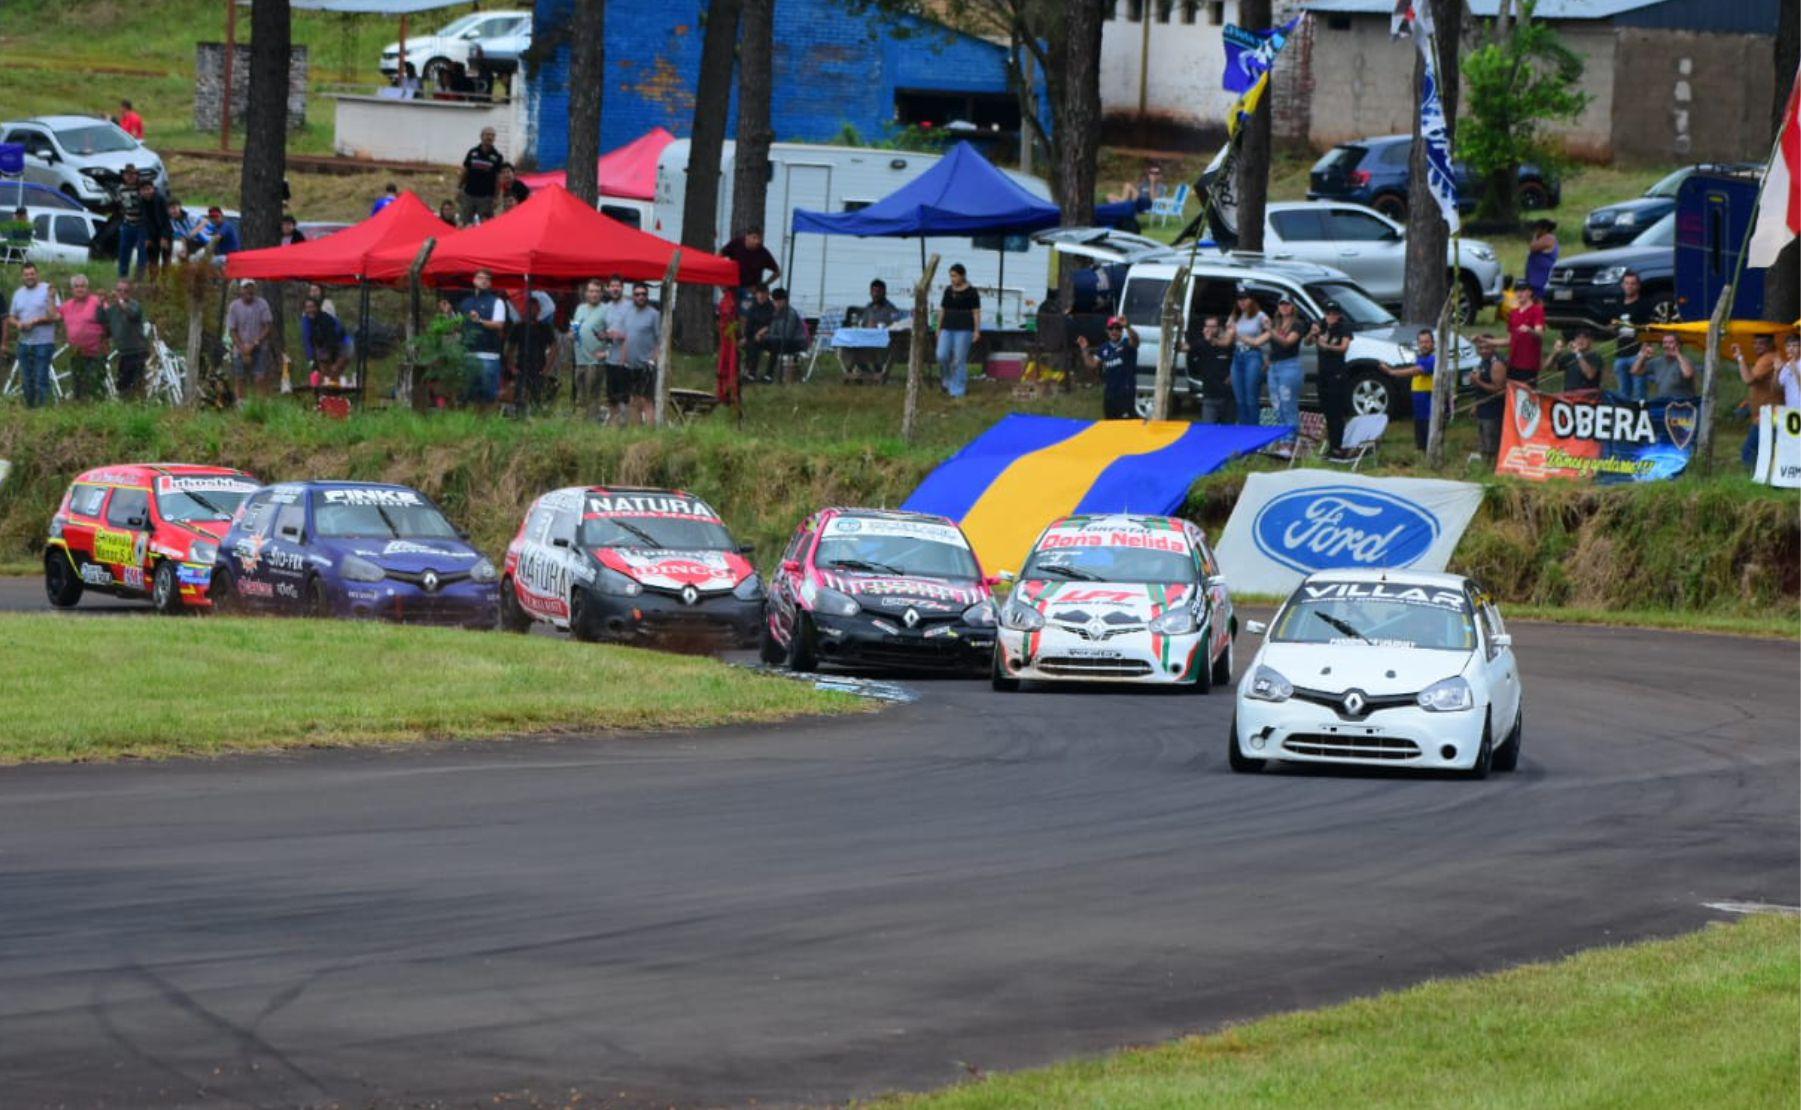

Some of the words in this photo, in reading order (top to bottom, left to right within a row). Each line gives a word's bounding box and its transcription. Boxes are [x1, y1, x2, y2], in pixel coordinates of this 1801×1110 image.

[1551, 399, 1657, 444] OBERÁ
[590, 497, 711, 518] NATURA
[1110, 532, 1185, 552] Nelida
[1283, 496, 1406, 563] Ford
[1304, 583, 1466, 612] VILLAR
